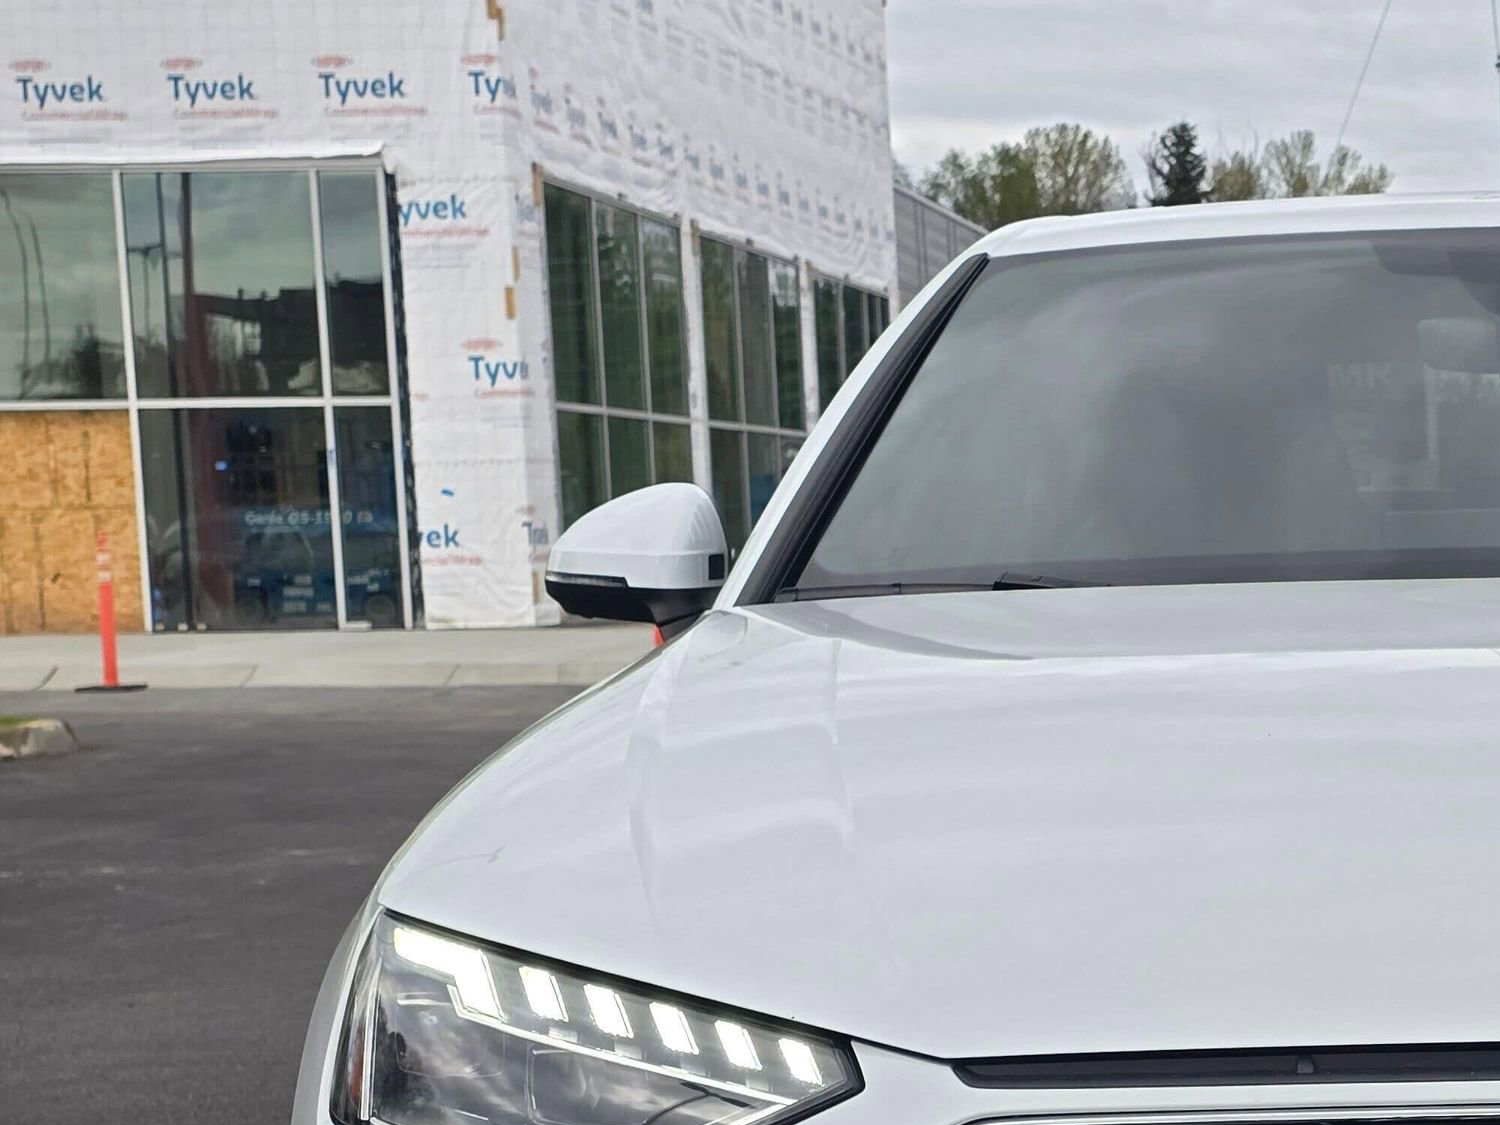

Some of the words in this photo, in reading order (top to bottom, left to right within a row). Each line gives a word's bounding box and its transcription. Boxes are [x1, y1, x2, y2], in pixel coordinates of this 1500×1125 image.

[15, 73, 104, 111] Tyvek
[166, 71, 255, 108] Tyvek
[318, 70, 405, 106] Tyvek
